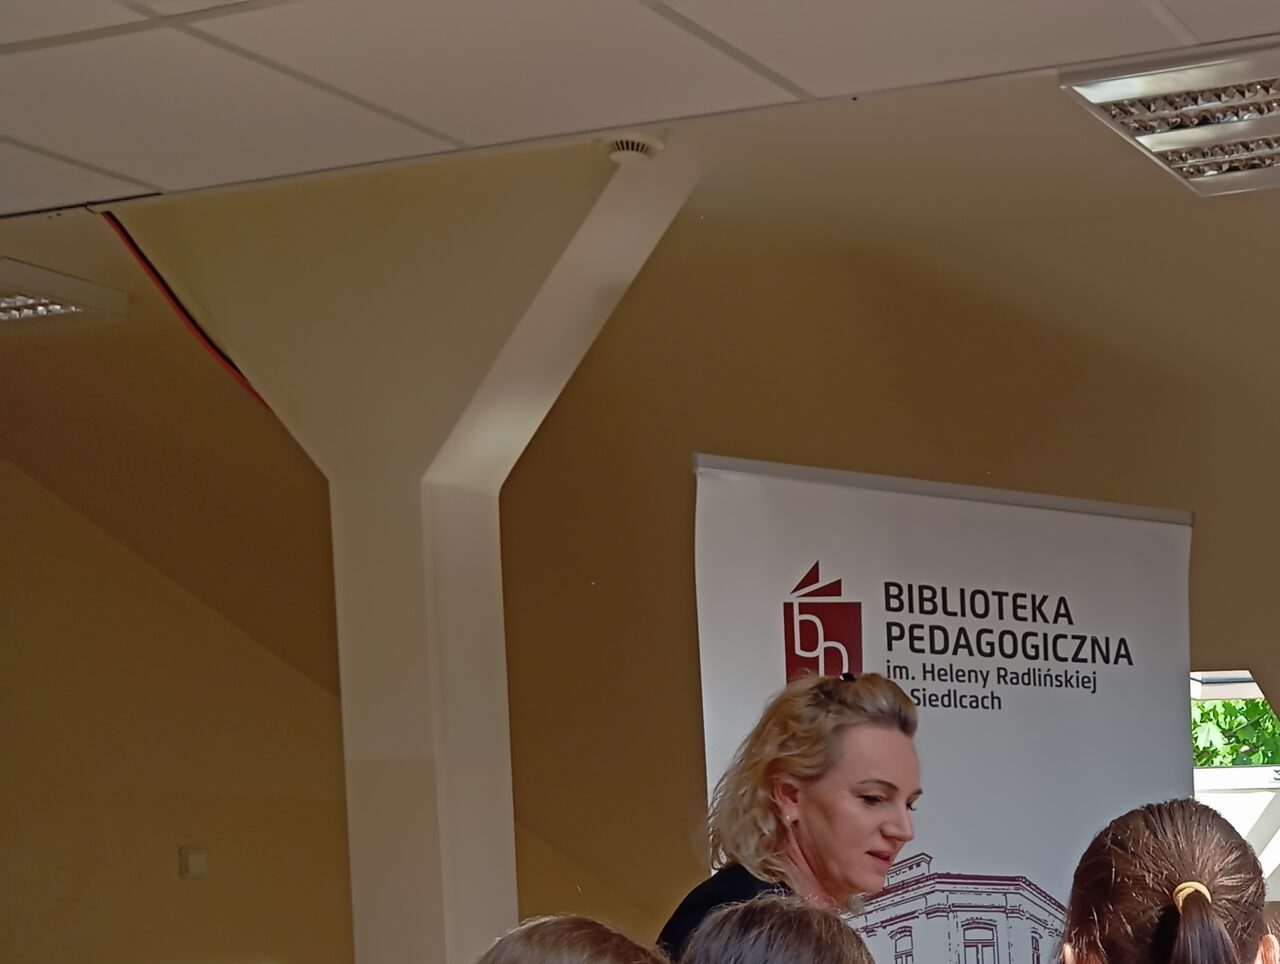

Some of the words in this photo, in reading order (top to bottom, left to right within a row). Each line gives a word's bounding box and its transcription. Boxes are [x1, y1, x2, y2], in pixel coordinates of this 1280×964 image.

[884, 581, 1074, 625] BIBLIOTEKA
[885, 621, 1134, 666] PEDAGOGICZNA
[886, 659, 916, 681] im.
[922, 663, 990, 689] Heleny
[996, 666, 1098, 694] Radlińskiej
[911, 687, 1002, 710] Siedlcach
